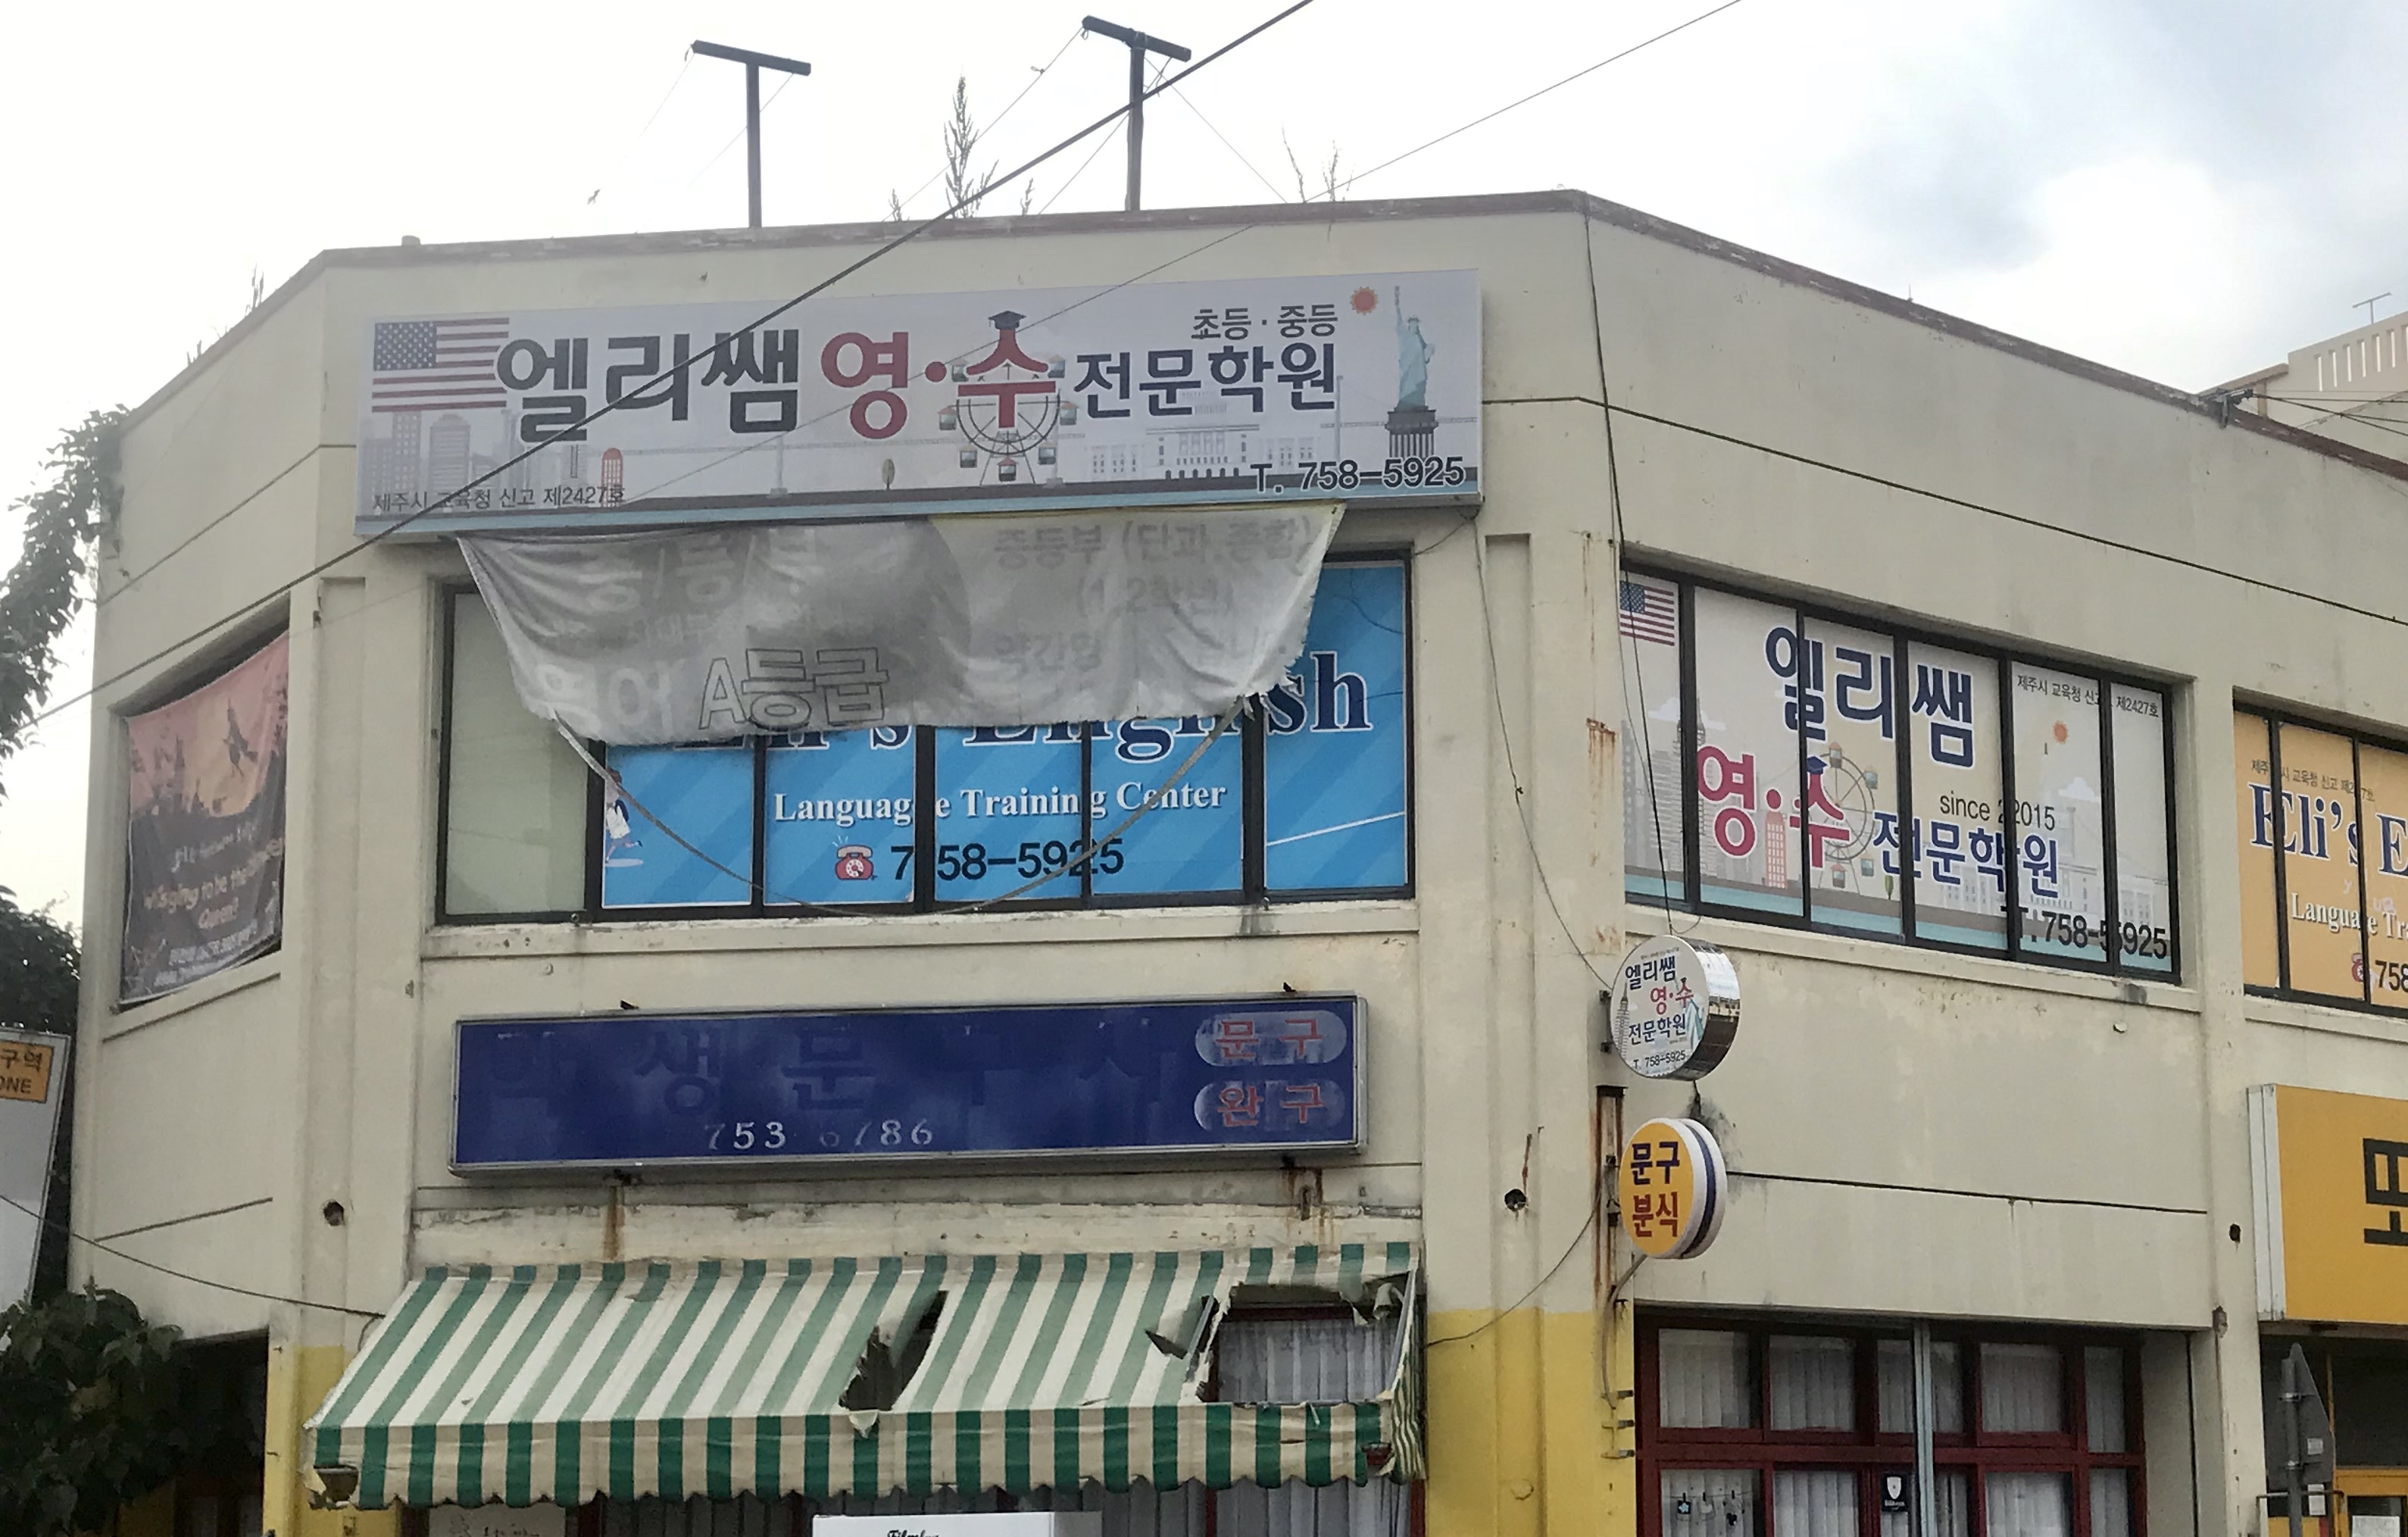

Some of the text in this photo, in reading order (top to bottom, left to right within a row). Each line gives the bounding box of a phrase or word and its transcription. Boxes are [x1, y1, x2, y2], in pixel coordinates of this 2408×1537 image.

[497, 330, 799, 442] 엘리쌤
[1073, 342, 1335, 419] 전문학원
[1250, 456, 1463, 493] T. 758-5925
[373, 491, 428, 512] 제주시
[499, 487, 535, 508] 신고
[543, 485, 625, 508] 제2427호
[995, 523, 1106, 570] 중등부
[698, 646, 889, 731] A등급
[1766, 626, 1973, 767] 엘리쌤
[2017, 674, 2047, 695] 제주시
[2051, 683, 2082, 703] 교육청
[2116, 695, 2159, 717] 제2427호
[2322, 774, 2338, 790] 신고
[775, 782, 1229, 827] Language Training Center
[1940, 791, 1990, 821] since
[1872, 811, 2058, 898] 전문학원
[2291, 892, 2378, 936] Languae
[1625, 956, 1676, 990] 엘리쌤
[1215, 1019, 1324, 1059] 문구
[1629, 1014, 1685, 1045] 전문학원
[1645, 1050, 1686, 1068] 758-5925
[1217, 1084, 1326, 1128] 완구
[1630, 1142, 1681, 1185] 문구
[1632, 1191, 1679, 1238] 분식
